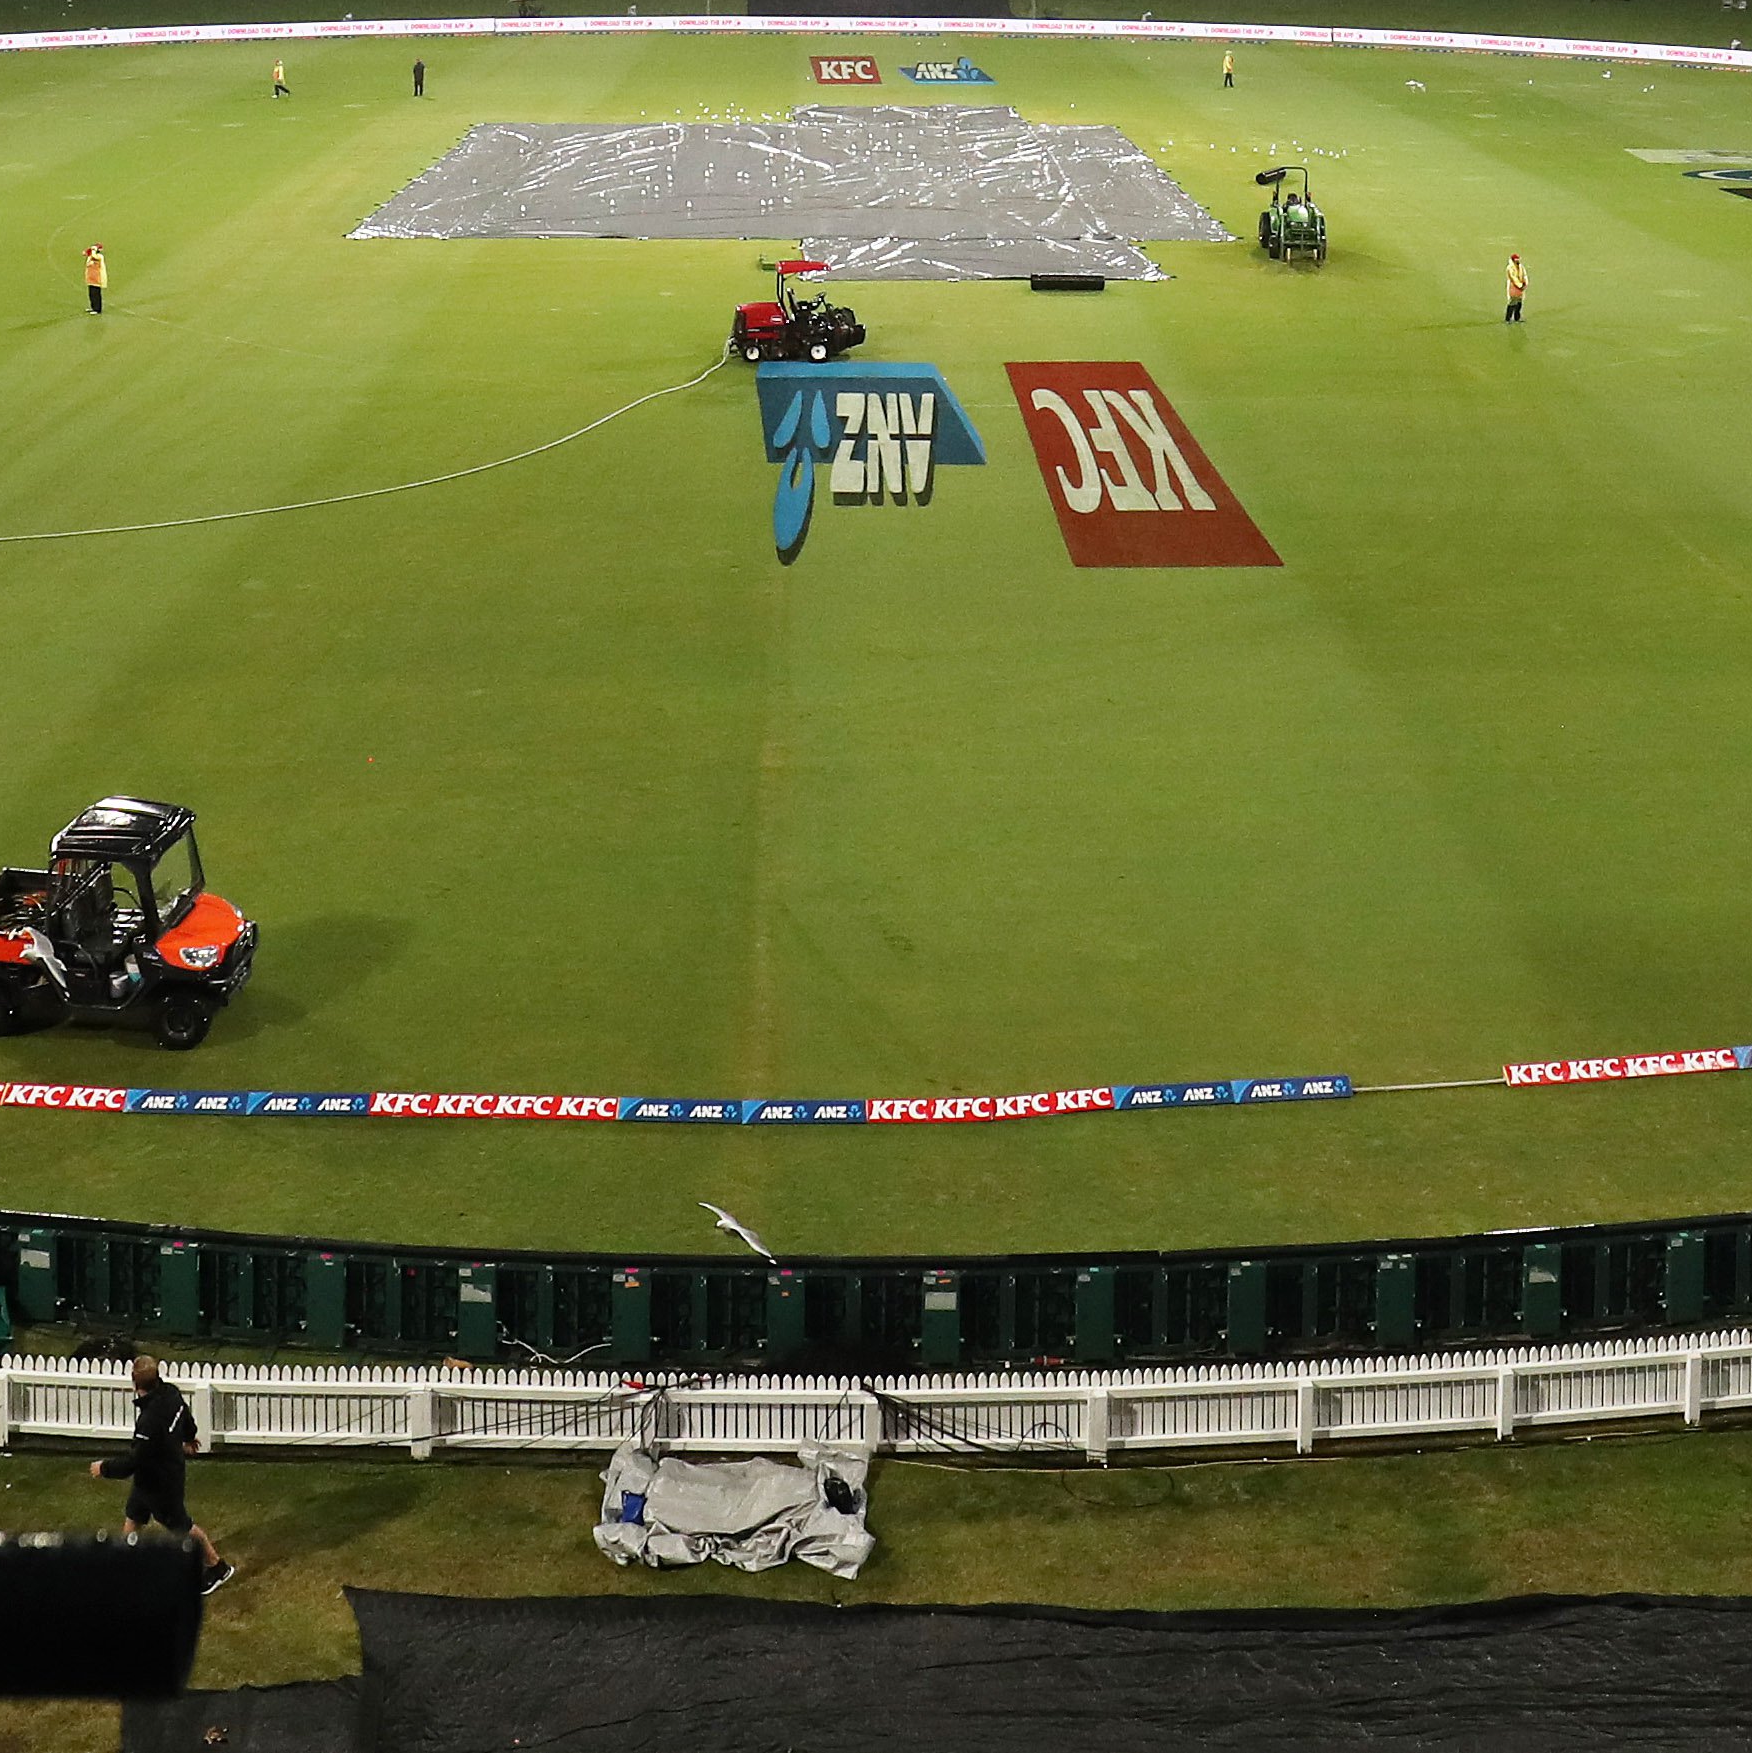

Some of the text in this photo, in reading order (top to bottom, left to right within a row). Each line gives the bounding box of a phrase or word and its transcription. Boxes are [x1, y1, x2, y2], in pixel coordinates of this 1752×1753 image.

[819, 61, 874, 79] KFC
[915, 63, 958, 80] ANZ
[830, 393, 934, 496] ANZ
[1031, 389, 1217, 513] KFC
[1510, 1049, 1734, 1084] KFC KFC KFC KFC
[5, 1085, 65, 1105] KFC
[66, 1088, 126, 1108] KFC
[142, 1096, 351, 1110] ANZ ANZ ANZ ANZ
[870, 1088, 1110, 1119] KFC KFC KFC KFC
[1132, 1080, 1334, 1104] ANZ ANZ ANZ ANZ
[371, 1093, 621, 1119] KFC KFC KFC KFC
[636, 1104, 846, 1118] ANZ ANZ ANZ ANZ
